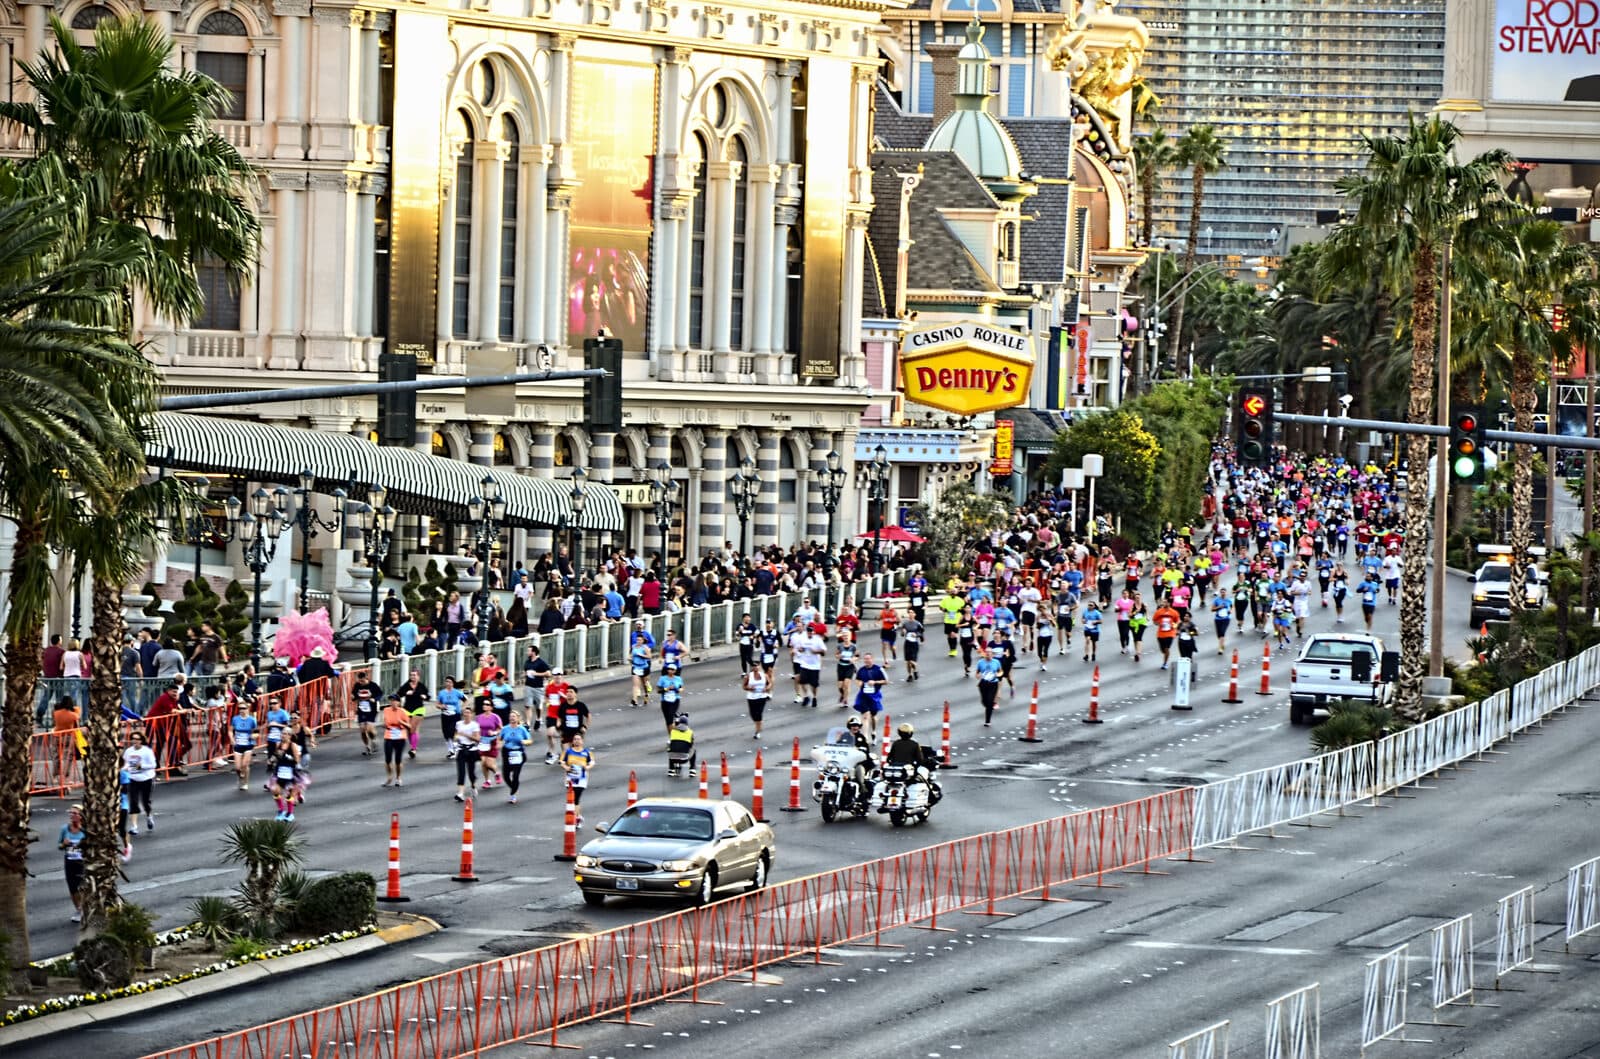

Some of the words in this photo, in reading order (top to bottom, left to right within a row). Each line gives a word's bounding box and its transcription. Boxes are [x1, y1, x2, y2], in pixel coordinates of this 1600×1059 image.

[1526, 0, 1599, 28] ROD
[912, 326, 964, 347] CASINO
[973, 327, 1025, 351] ROYALE
[916, 366, 1018, 395] Denny's
[421, 404, 446, 415] Parfums
